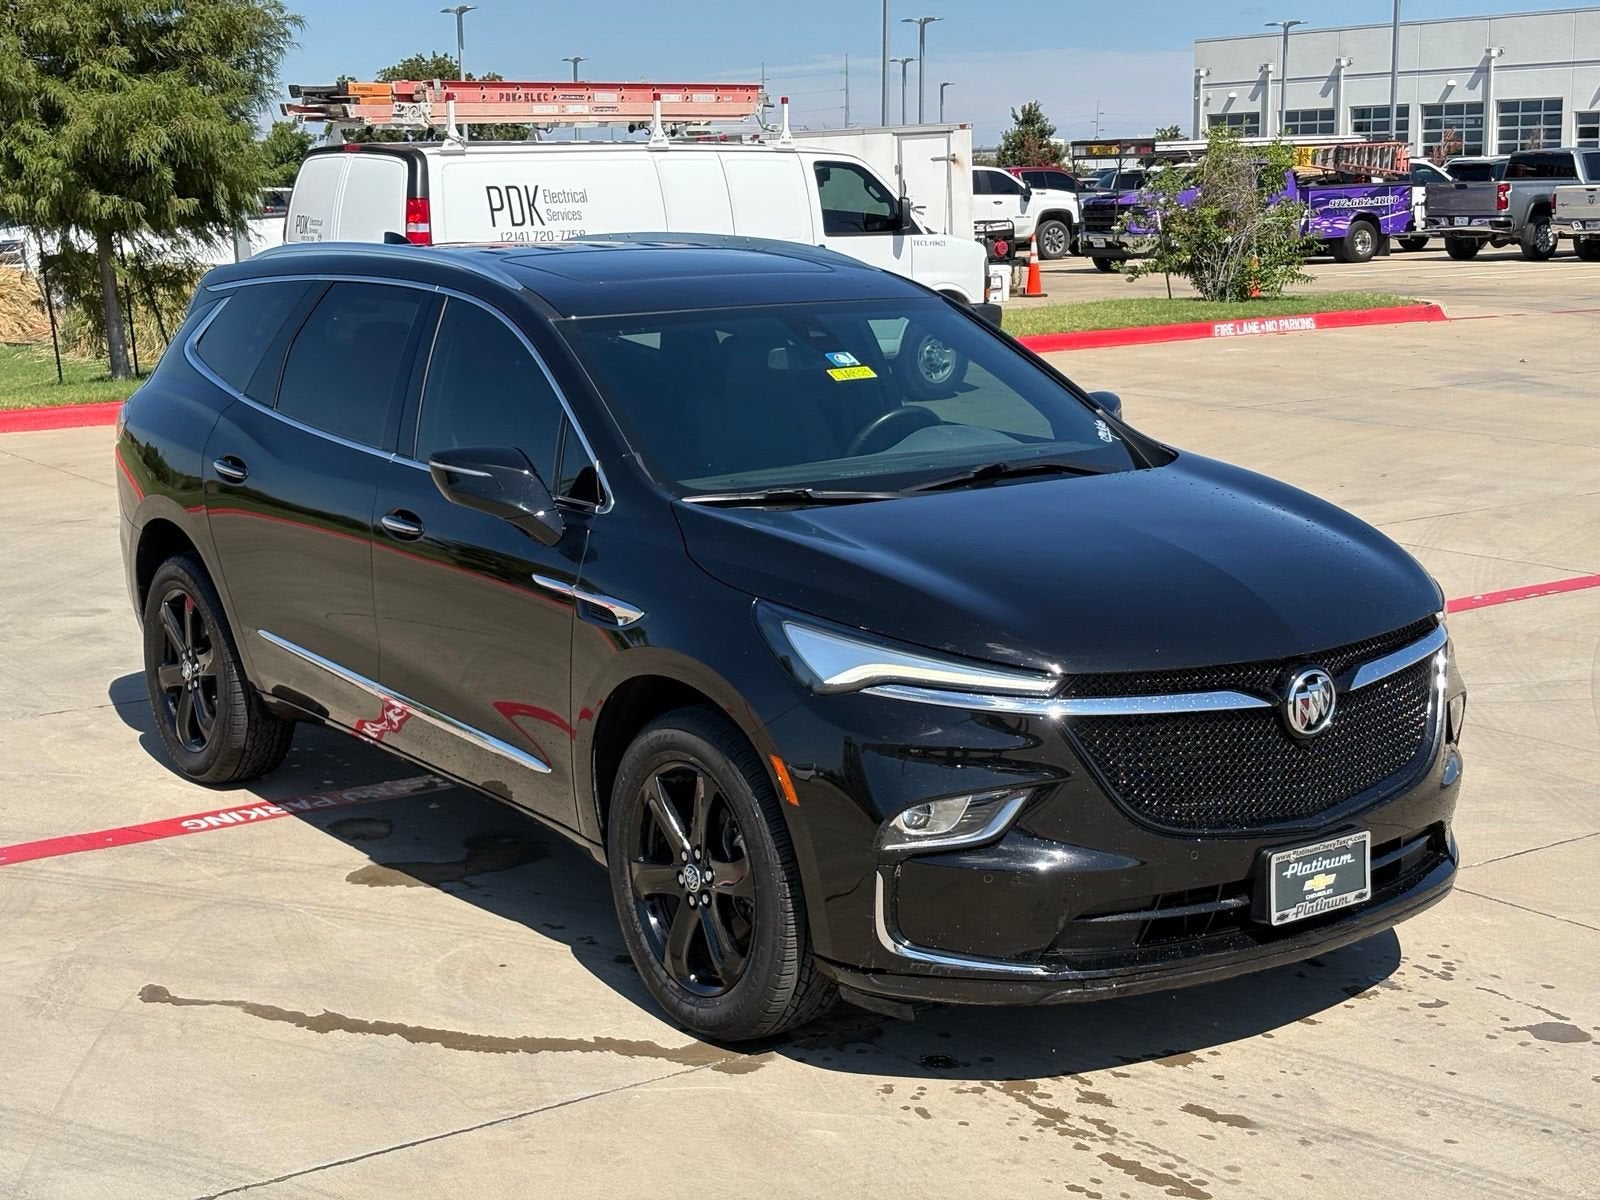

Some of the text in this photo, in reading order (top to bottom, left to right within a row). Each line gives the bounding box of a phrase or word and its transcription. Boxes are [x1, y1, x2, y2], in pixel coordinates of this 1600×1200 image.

[485, 185, 546, 227] PDK
[542, 188, 588, 204] Electrical
[546, 208, 583, 221] Services
[1214, 317, 1315, 336] FIRE LANE NO PARKING
[1282, 853, 1356, 879] Platinum
[1291, 895, 1352, 919] Platinum
